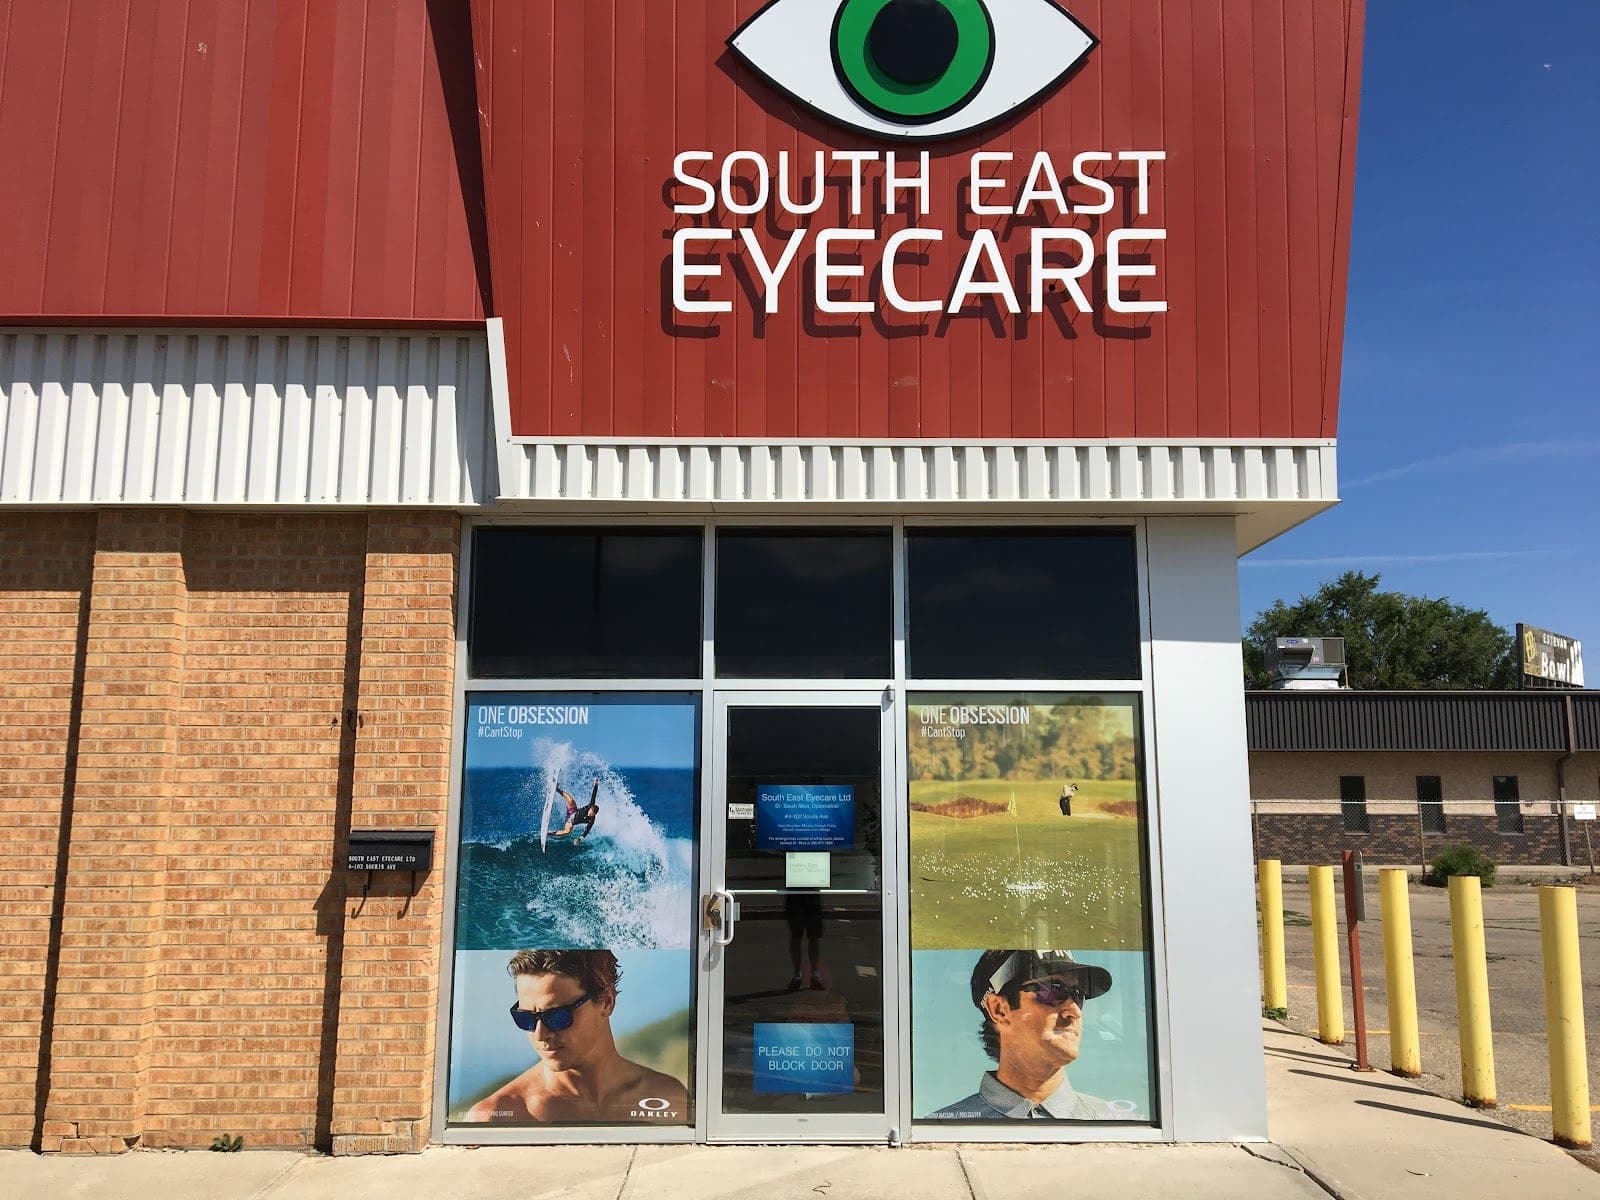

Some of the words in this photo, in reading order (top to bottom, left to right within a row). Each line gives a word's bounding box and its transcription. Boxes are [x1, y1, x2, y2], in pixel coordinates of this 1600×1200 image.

[673, 150, 930, 215] SOUTH
[970, 150, 1166, 215] EAST
[672, 227, 1168, 314] EYECARE
[1543, 633, 1567, 650] ESTEVAN
[478, 706, 505, 725] ONE
[508, 706, 589, 725] OBSESSION
[920, 706, 947, 725] ONE
[949, 706, 1030, 725] OBSESSION
[478, 726, 523, 739] #CantStop
[921, 726, 966, 739] #CantStop
[761, 793, 784, 801] South
[786, 793, 803, 801] East
[805, 793, 837, 803] Eyecare
[838, 793, 851, 801] Ltd
[758, 1046, 800, 1057] PLEASE
[805, 1046, 822, 1057] DO
[828, 1046, 851, 1057] NOT
[768, 1060, 806, 1071] BLOCK
[811, 1060, 844, 1071] DOOR
[630, 1110, 678, 1118] OAKLEY
